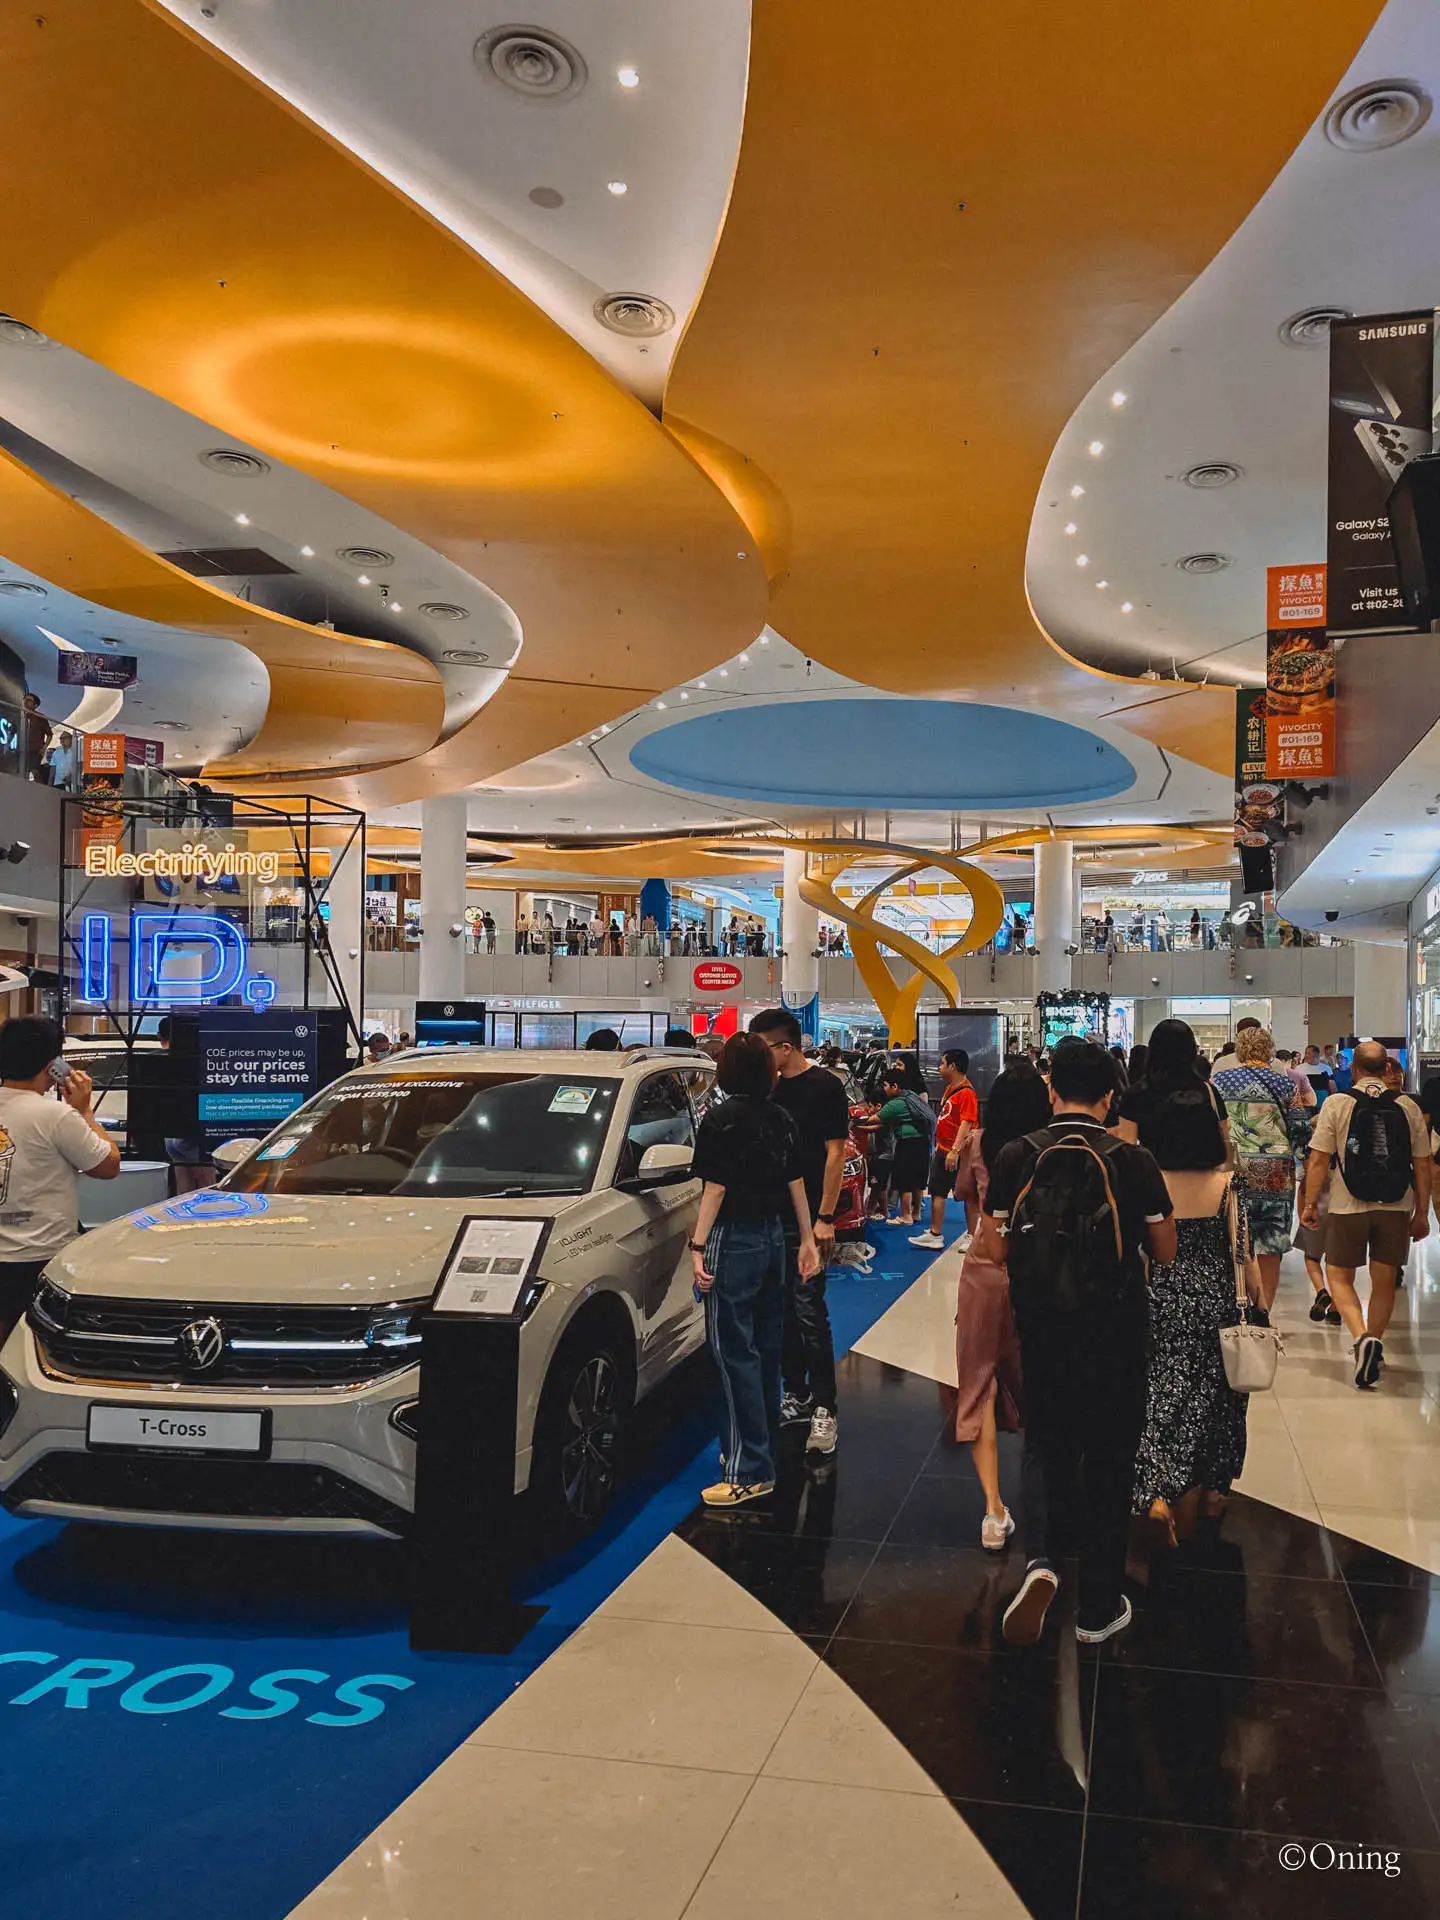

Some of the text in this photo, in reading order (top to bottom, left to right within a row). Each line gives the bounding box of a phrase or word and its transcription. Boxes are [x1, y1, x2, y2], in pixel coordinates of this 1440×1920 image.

[1358, 323, 1427, 341] SAMSUNG
[1335, 519, 1376, 531] Galaxy
[1352, 531, 1386, 541] Galaxy
[1359, 587, 1398, 598] Visit us
[1280, 595, 1323, 605] VIVOCITY
[1351, 602, 1364, 611] at
[1281, 607, 1320, 617] #01-169
[1278, 723, 1323, 732] VIVOCITY
[1280, 735, 1319, 744] #01-169
[1245, 763, 1266, 771] LEVE
[84, 843, 280, 883] Electrifying
[513, 1000, 562, 1009] HILFIGER
[206, 1048, 306, 1059] COE prices may be up,
[206, 1058, 306, 1073] but our prices
[206, 1071, 309, 1086] stay the same
[329, 1092, 361, 1101] FROM
[139, 1418, 207, 1437] T-Cross
